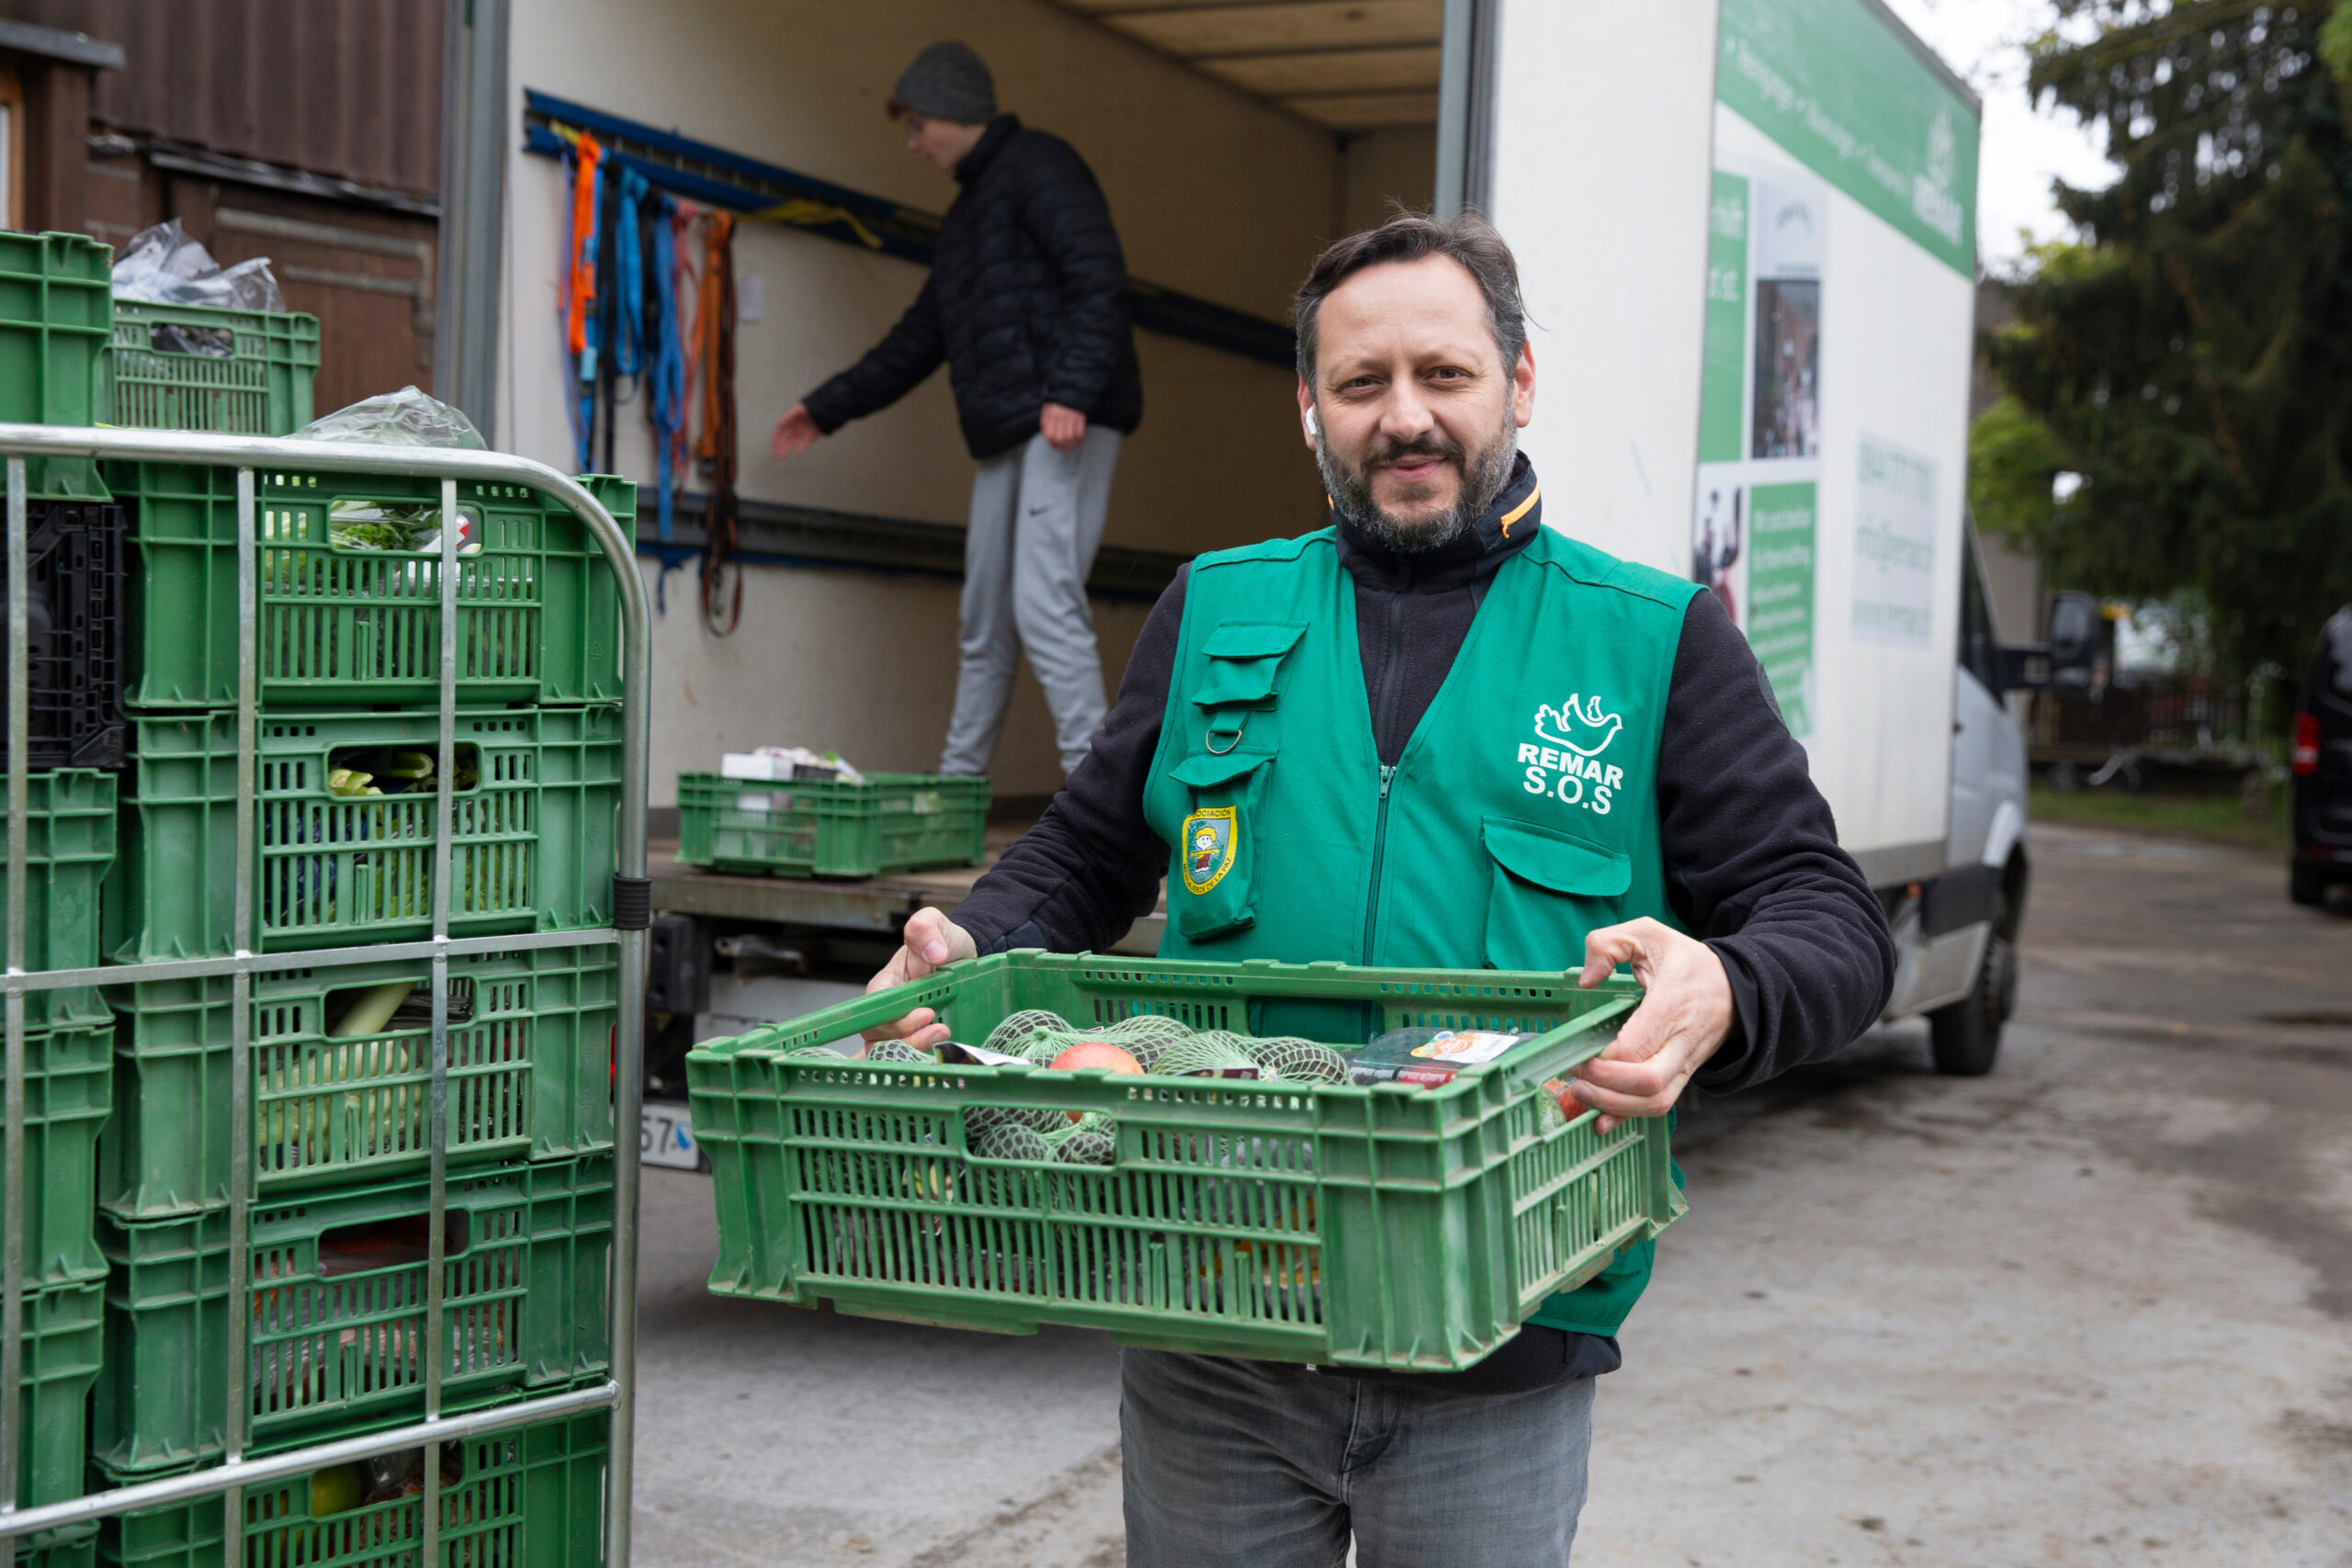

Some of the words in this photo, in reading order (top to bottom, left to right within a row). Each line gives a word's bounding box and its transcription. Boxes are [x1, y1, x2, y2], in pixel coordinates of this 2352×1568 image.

[1518, 742, 1623, 791] REMAR
[1522, 766, 1612, 815] S.O.S
[1221, 857, 1232, 873] PAZ
